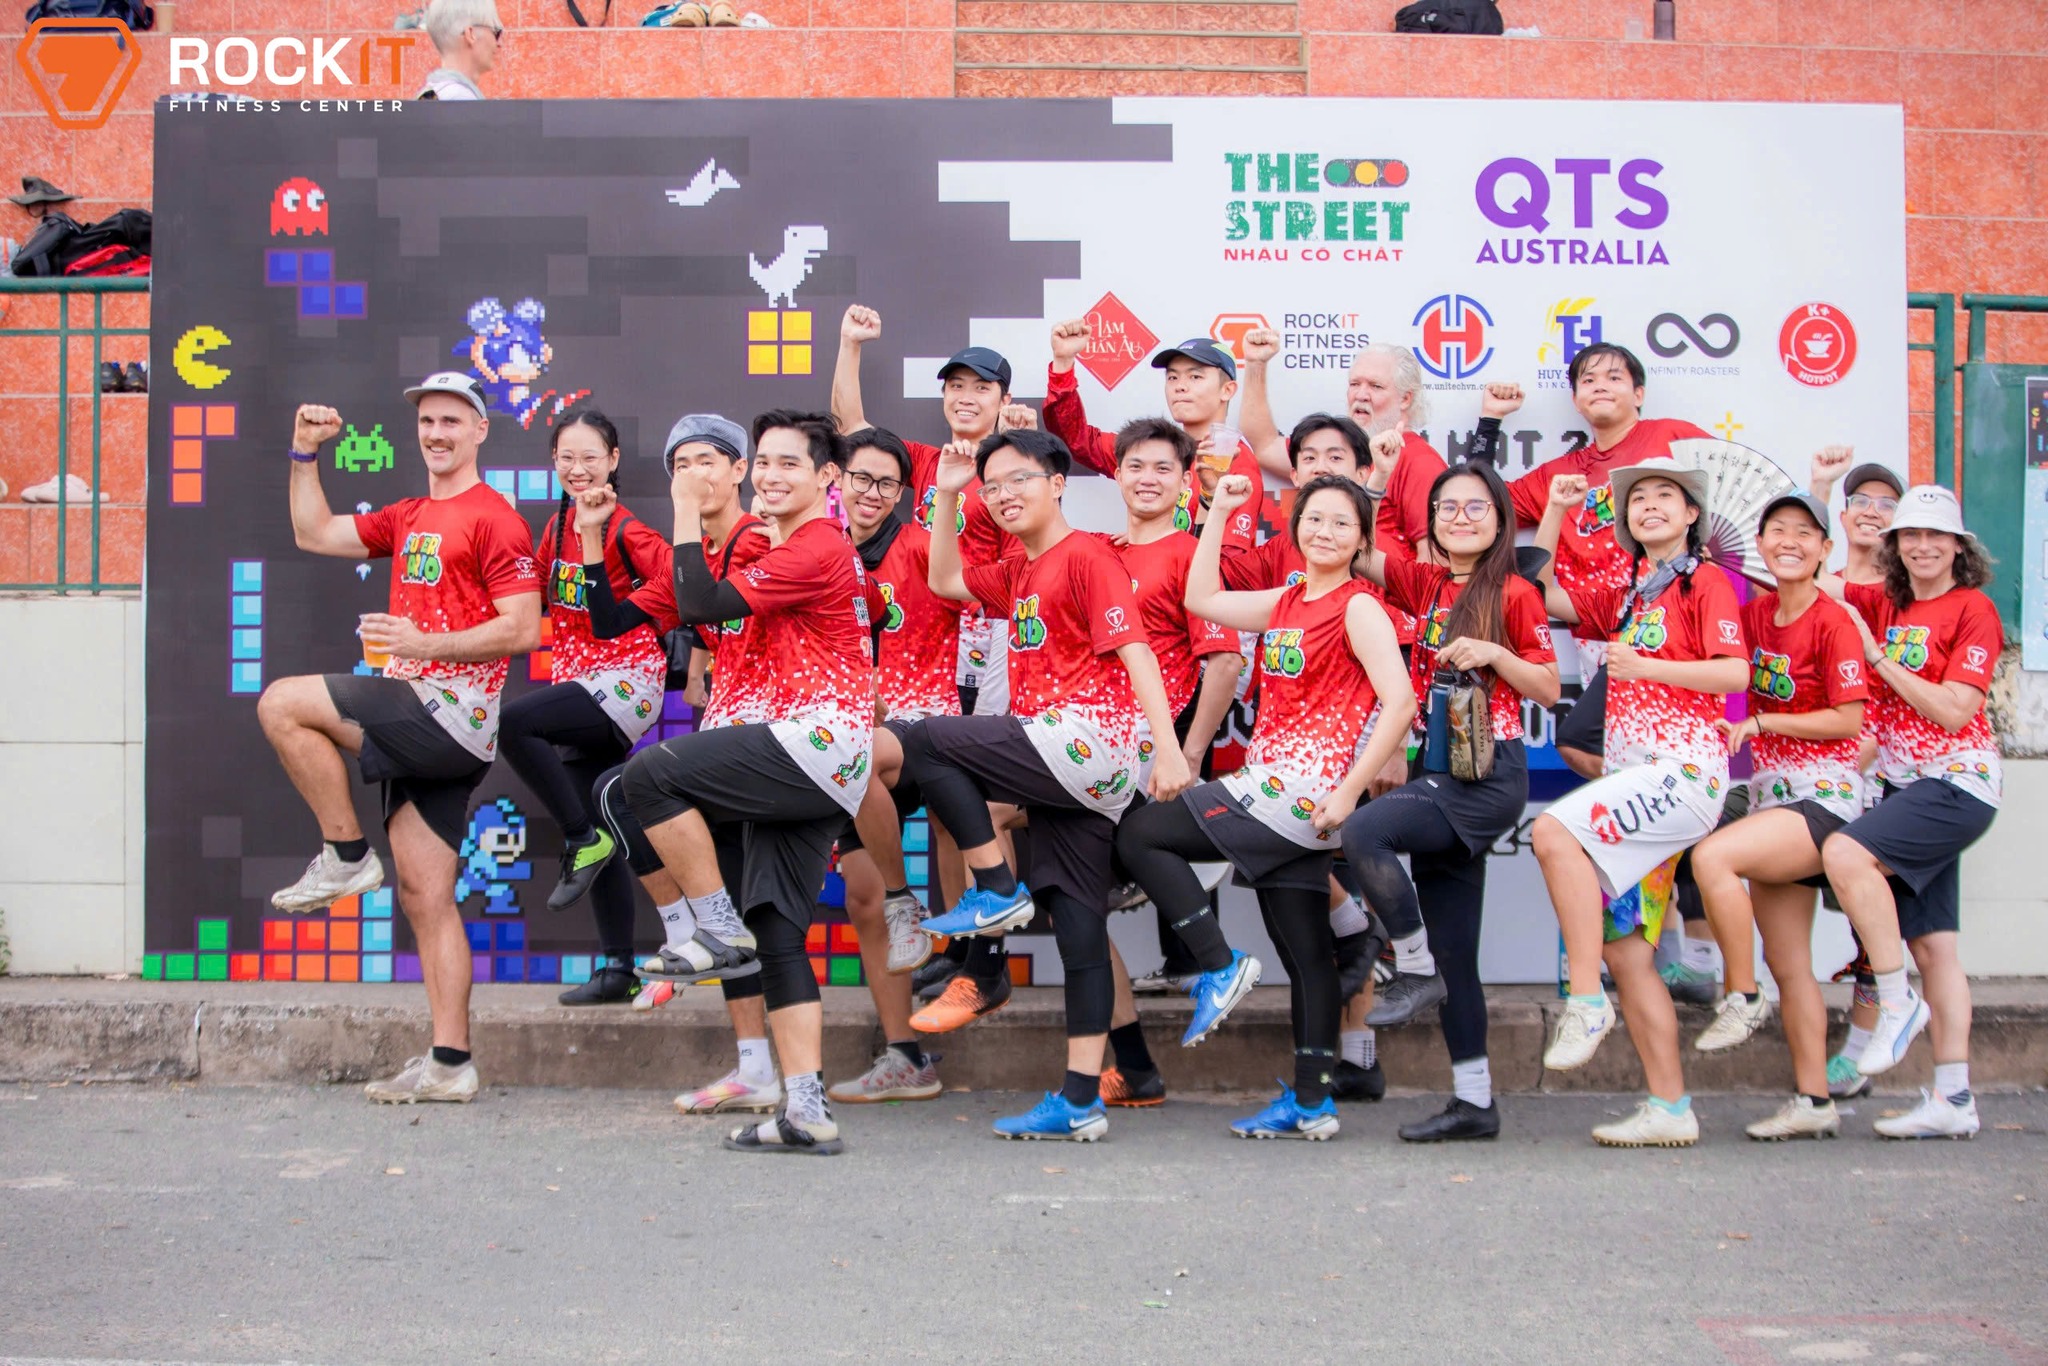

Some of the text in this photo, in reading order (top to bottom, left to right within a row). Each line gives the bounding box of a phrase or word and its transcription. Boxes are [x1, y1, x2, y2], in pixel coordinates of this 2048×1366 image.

[1224, 152, 1320, 192] THE
[1475, 157, 1670, 234] QTS
[1224, 200, 1410, 241] STREET
[1475, 238, 1670, 265] AUSTRALIA
[1284, 313, 1360, 329] ROCKIT
[1284, 334, 1370, 349] FITNESS
[1284, 354, 1357, 369] CENTE
[1538, 369, 1562, 380] HUY
[1647, 367, 1740, 376] INFINITY ROASTERS
[1798, 371, 1840, 385] HOTPOT
[1423, 381, 1487, 391] w.unitechvn.c
[1108, 625, 1130, 636] TITAN
[1205, 633, 1225, 641] TITAN
